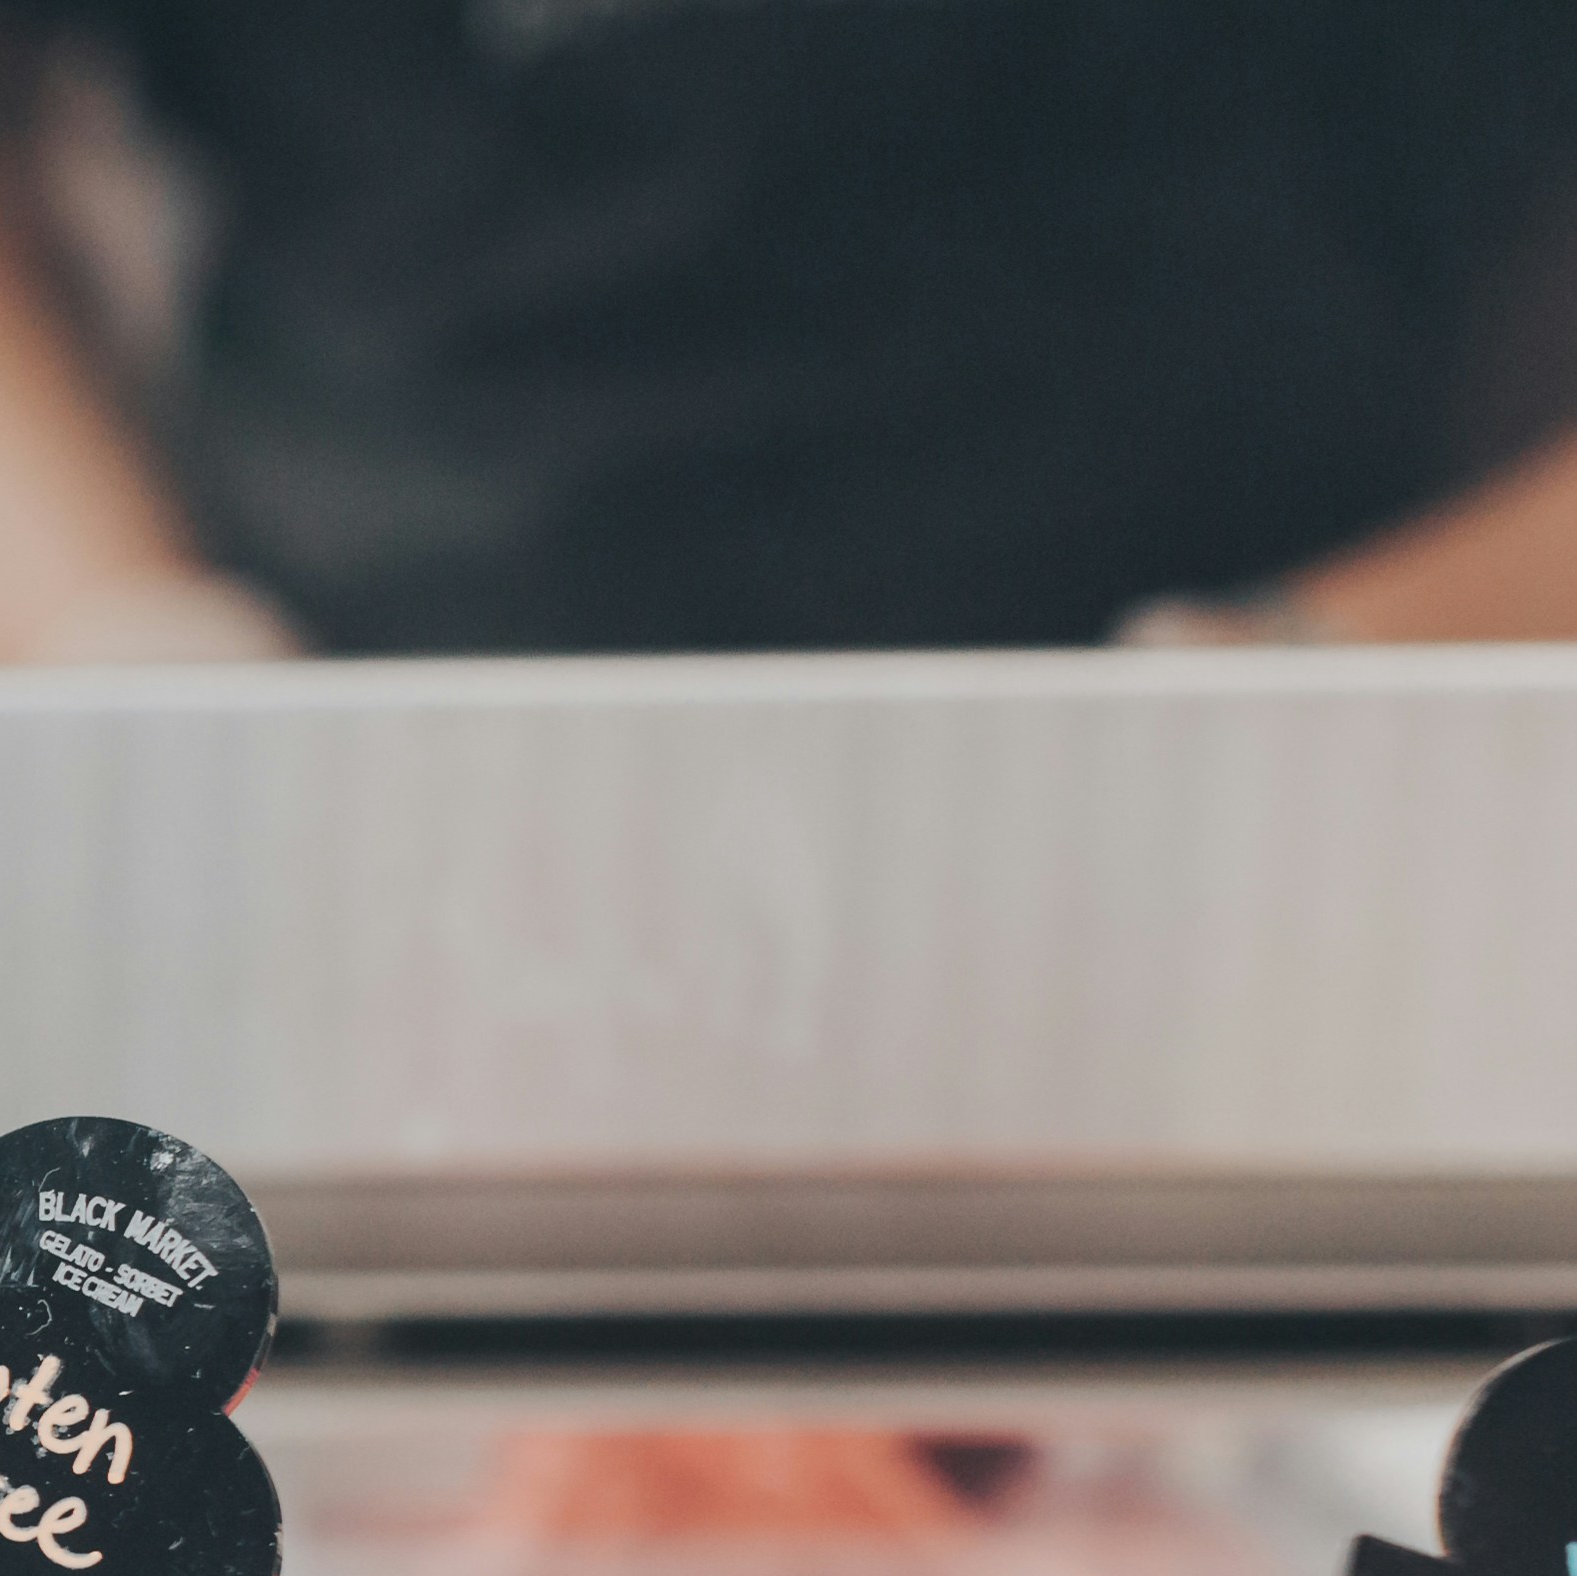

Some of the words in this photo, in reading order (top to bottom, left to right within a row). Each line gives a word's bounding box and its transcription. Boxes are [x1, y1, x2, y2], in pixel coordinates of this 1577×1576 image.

[38, 1190, 127, 1232] BLACK
[39, 1230, 106, 1271] GELATO
[113, 1264, 184, 1308] SORBET
[51, 1262, 88, 1292] ICE
[81, 1276, 144, 1318] CREAM
